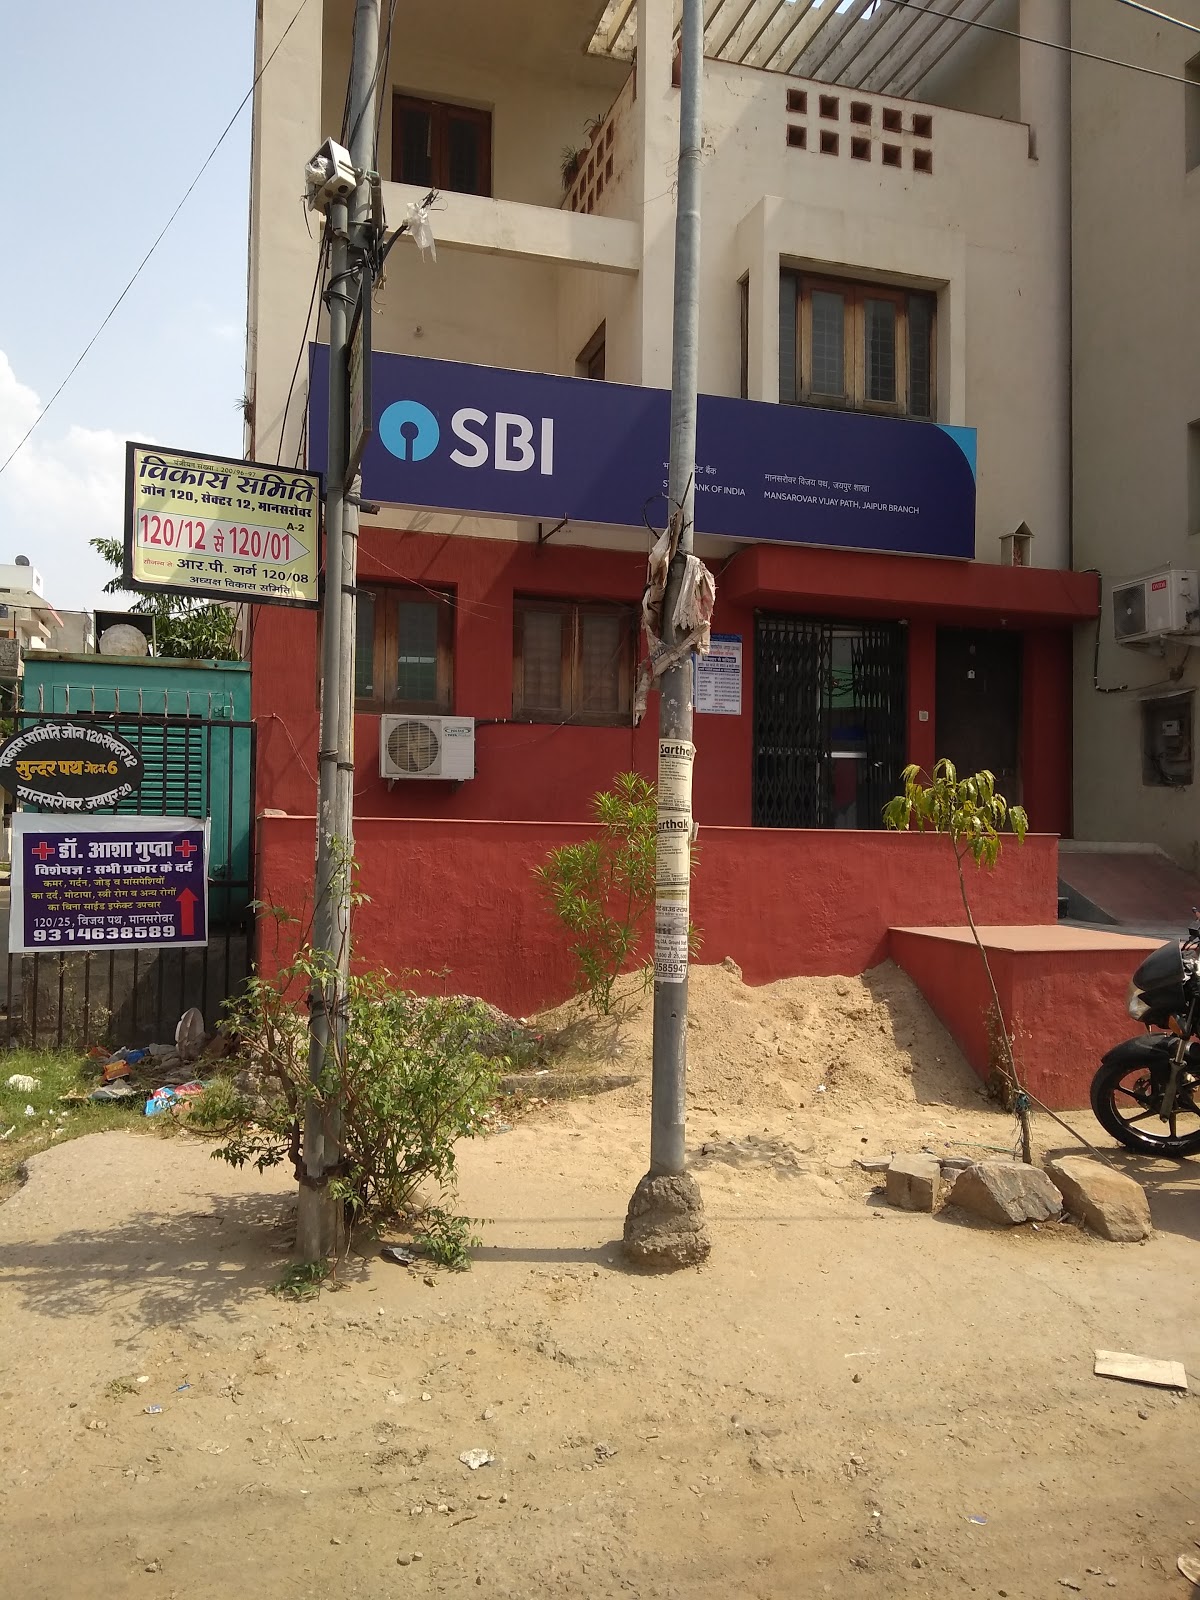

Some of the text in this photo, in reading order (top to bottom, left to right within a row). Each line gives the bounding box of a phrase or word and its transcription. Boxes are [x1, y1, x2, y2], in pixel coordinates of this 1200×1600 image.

[449, 407, 554, 476] SBI
[139, 455, 316, 502] विकास समिति
[764, 473, 797, 485] मानसरोवर
[798, 475, 816, 487] विजय
[833, 481, 852, 493] जयपुर
[853, 484, 870, 493] शाखा
[693, 482, 746, 496] ANK OF INDIA
[141, 484, 313, 518] जोन 120, सेक्टर 12, मानसरोवर
[763, 490, 920, 515] MANSAROVAR VIJAY PATH, JAIPUR BRANCH
[286, 522, 305, 532] A-2
[140, 514, 290, 561] 120/12 से 120/01
[232, 563, 258, 577] गर्ग
[262, 569, 309, 584] 120/08
[189, 575, 291, 595] अध्यक्ष विकास समिति
[23, 723, 61, 744] समिति
[61, 722, 86, 740] जोन
[86, 728, 102, 744] 120
[102, 732, 131, 761] सेक्टर
[124, 754, 138, 768] 12
[15, 760, 58, 781] सुन्दर
[58, 760, 84, 775] पथ
[58, 838, 174, 862] डॉ. आशा गुप्ता
[35, 863, 84, 876] विशेषज्ञ
[94, 862, 120, 875] सभी
[123, 863, 158, 875] प्रकार
[160, 861, 172, 873] के
[175, 861, 193, 873] दर्द
[42, 879, 67, 888] कमर,
[69, 877, 92, 888] गर्दन,
[93, 877, 111, 888] जोड़
[122, 875, 165, 886] मांसपेशियों
[31, 891, 44, 900] का
[46, 890, 62, 900] दर्द,
[64, 889, 95, 900] मोटापा,
[97, 889, 112, 899] स्त्री
[114, 888, 129, 898] रोग
[140, 889, 158, 897] अन्य
[160, 886, 177, 897] रोगों
[47, 900, 162, 912] का बिना साईड इफेक्ट उपचार
[33, 911, 175, 928] 120/25, विजय पथ, मानसरोवर
[33, 925, 176, 943] 9314638589
